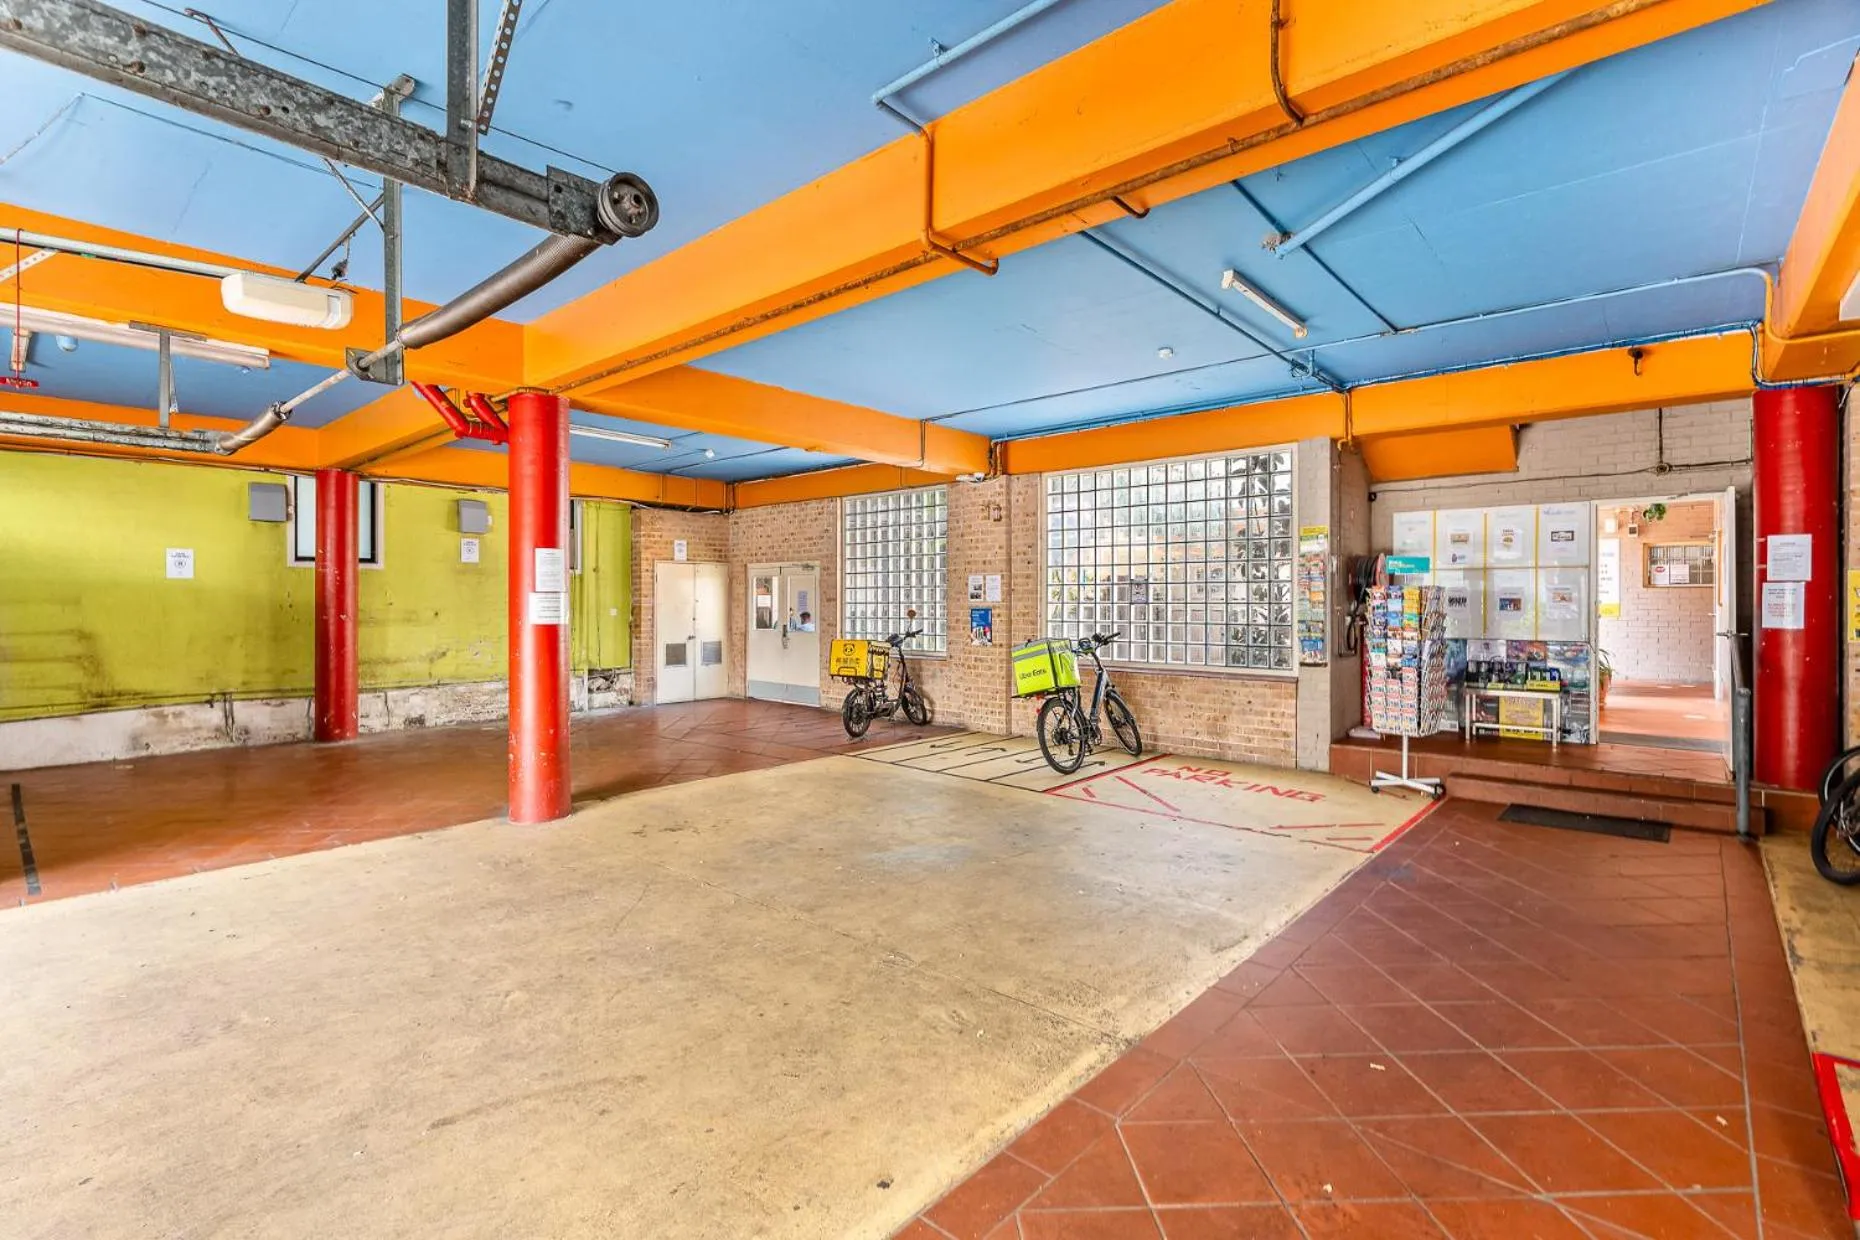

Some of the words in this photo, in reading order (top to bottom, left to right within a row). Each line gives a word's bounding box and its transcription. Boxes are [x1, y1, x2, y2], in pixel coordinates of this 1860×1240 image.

[1032, 668, 1047, 676] Eats
[1177, 765, 1232, 777] NO
[1140, 768, 1326, 802] PARKING
